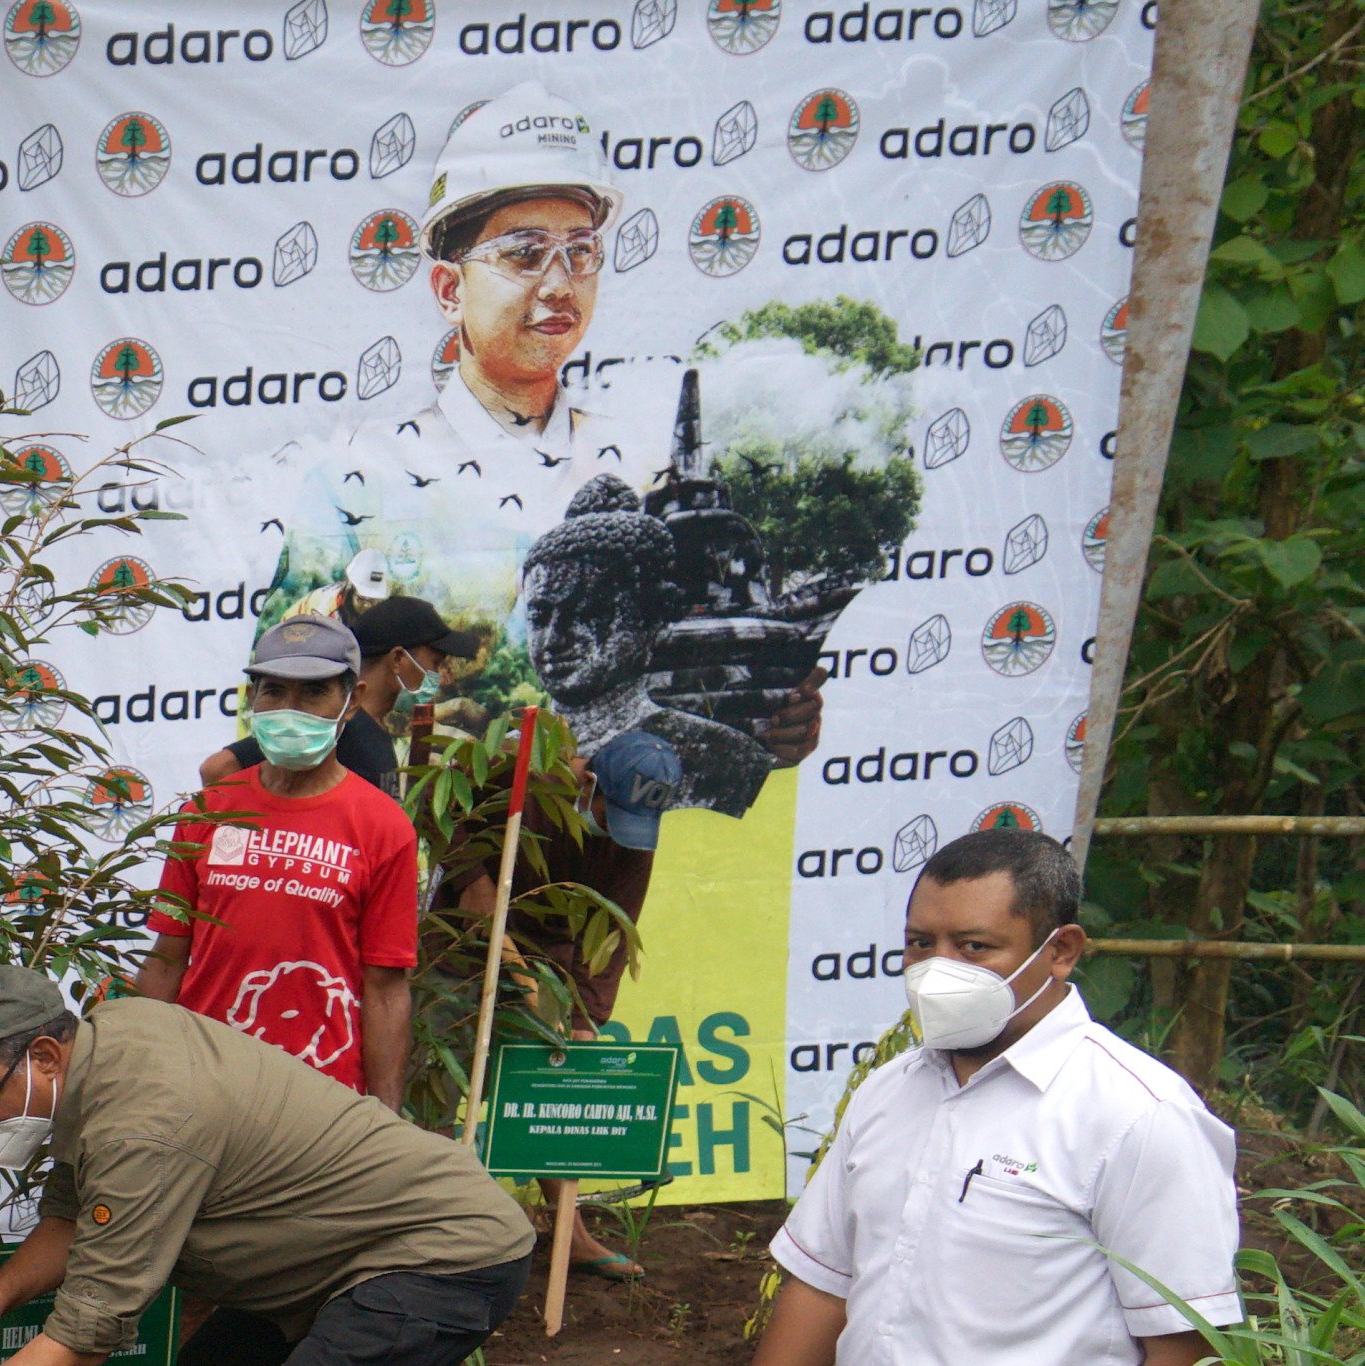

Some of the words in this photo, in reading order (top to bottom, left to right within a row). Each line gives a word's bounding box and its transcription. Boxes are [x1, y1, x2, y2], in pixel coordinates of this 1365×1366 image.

[459, 13, 621, 56] adaro
[803, 3, 963, 44] adaro
[106, 23, 273, 66] adaro
[499, 115, 575, 138] adaro
[537, 133, 577, 145] MINING
[879, 118, 1036, 160] adaro
[195, 143, 360, 187] adaro
[601, 131, 703, 170] aro
[782, 224, 938, 267] adaro
[99, 252, 263, 295] adaro
[187, 367, 347, 409] adaro
[181, 580, 270, 622] ada
[818, 646, 897, 680] aro
[822, 747, 979, 785] adaro
[248, 828, 353, 868] ELEPHANT
[797, 846, 884, 878] aro
[248, 854, 351, 884] GYPSUM
[207, 870, 260, 891] Image
[263, 877, 285, 893] of
[285, 879, 345, 908] Quality
[811, 944, 906, 981] ada
[600, 1011, 751, 1085] AS
[790, 1040, 879, 1073] aro
[503, 1102, 521, 1119] DR.
[522, 1103, 537, 1119] IR.
[538, 1103, 581, 1119] KUNCORO
[583, 1104, 615, 1121] CAHYO
[529, 1125, 563, 1135] KEPALA
[563, 1125, 590, 1135] DINAS
[992, 1153, 1025, 1170] adaro
